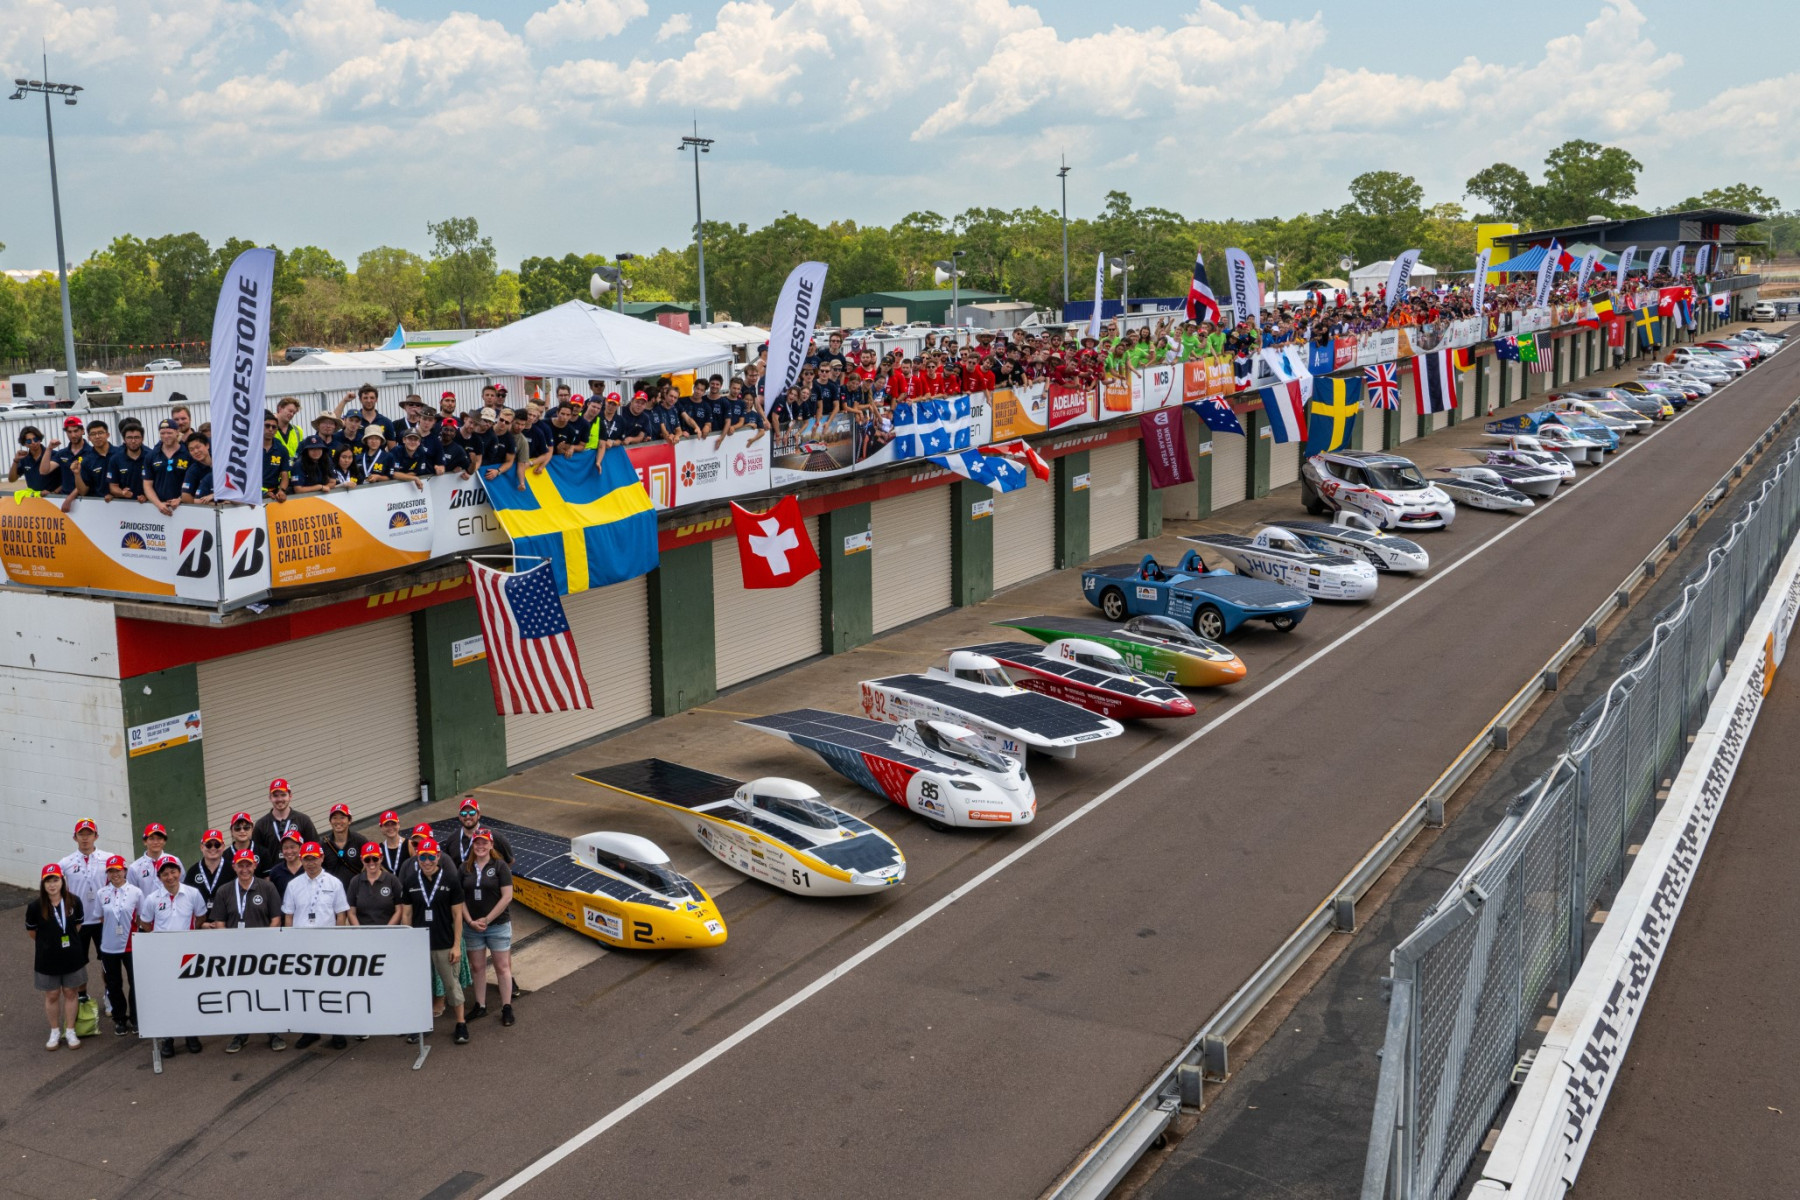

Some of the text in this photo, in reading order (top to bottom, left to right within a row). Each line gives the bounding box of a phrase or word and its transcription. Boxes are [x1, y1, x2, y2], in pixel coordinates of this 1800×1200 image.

[224, 276, 258, 496] BRIDGESTONE
[1154, 371, 1169, 386] MCB
[1053, 391, 1084, 410] ADELAIDE
[1156, 428, 1169, 467] SOLAR TEAM
[1164, 427, 1180, 480] WESTERN SYDNEY
[696, 461, 720, 472] NORTHERN
[696, 470, 718, 480] TERRITORY
[387, 498, 426, 511] BRIDGESTONE
[2, 515, 65, 531] BRIDGESTONE
[120, 521, 165, 532] BRIDGESTONE
[275, 511, 340, 535] BRIDGESTONE
[2, 530, 67, 545] WORLD SOLAR
[276, 526, 342, 550] WORLD SOLAR
[1257, 536, 1267, 547] 23
[3, 543, 56, 559] CHALLENGE
[278, 542, 332, 564] CHALLENGE
[1390, 553, 1399, 561] 77
[1253, 559, 1288, 579] HUST
[1084, 577, 1096, 590] 14
[454, 643, 461, 653] 51
[1060, 642, 1070, 658] 15
[875, 690, 886, 714] 92
[132, 729, 142, 740] 02
[921, 781, 938, 800] 85
[792, 869, 810, 888] 51
[634, 921, 655, 944] 2
[178, 954, 386, 979] BRIDGESTONE
[197, 989, 371, 1015] ENLITEN
